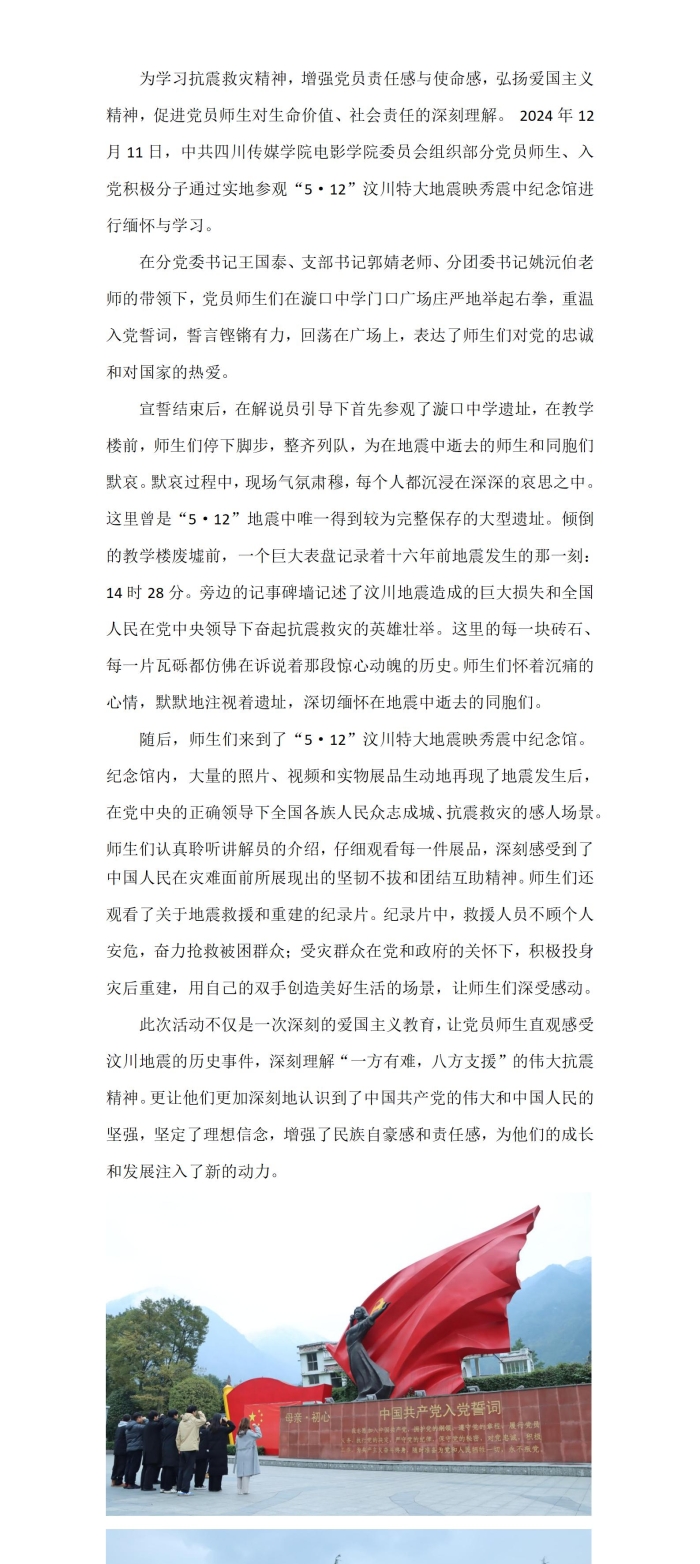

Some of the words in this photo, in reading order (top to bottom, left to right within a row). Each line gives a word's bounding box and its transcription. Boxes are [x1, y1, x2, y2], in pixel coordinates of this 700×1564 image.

[380, 1400, 501, 1421] 中国共产党入党誓词
